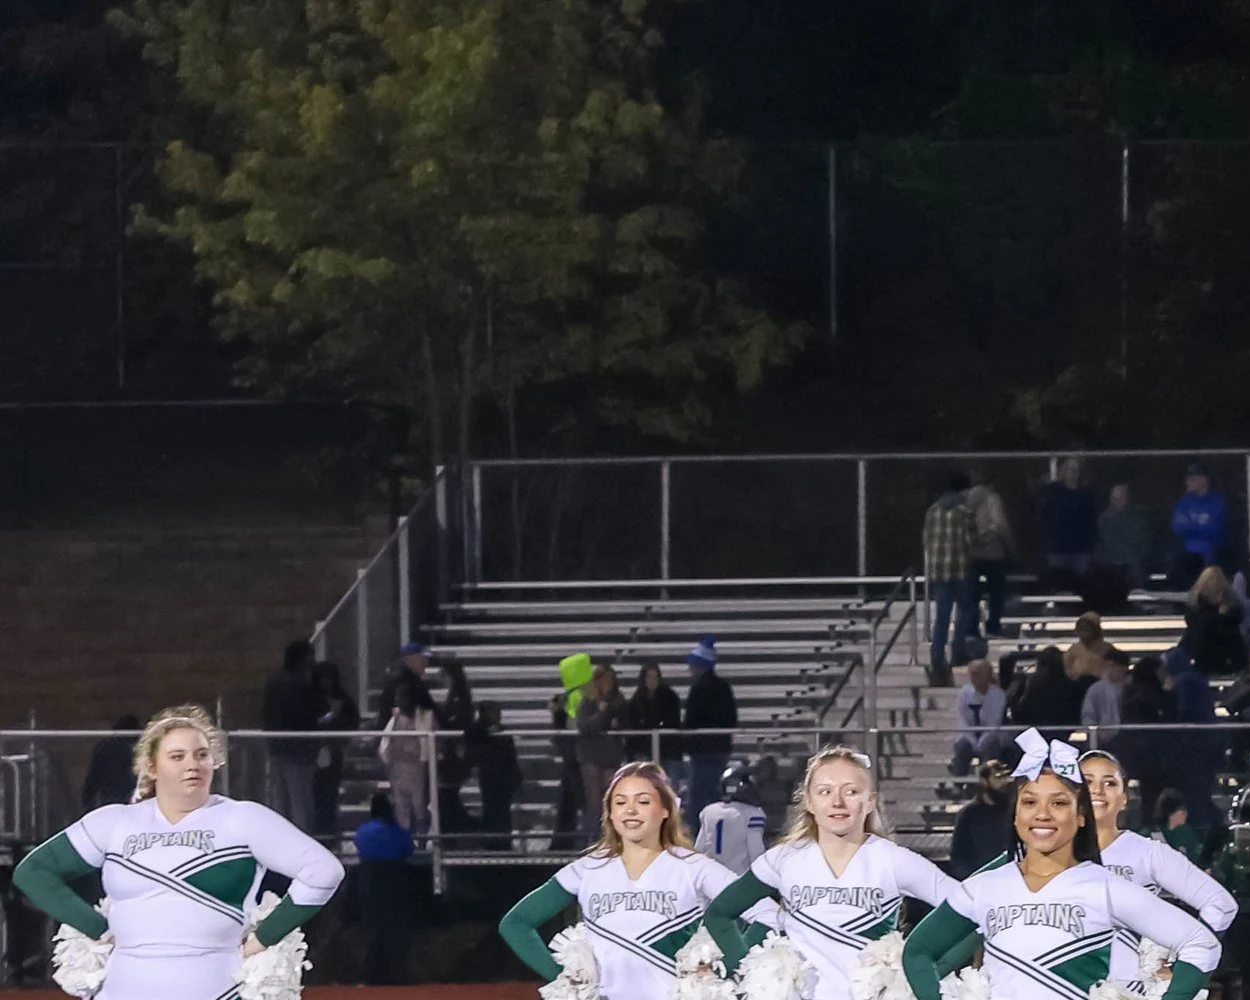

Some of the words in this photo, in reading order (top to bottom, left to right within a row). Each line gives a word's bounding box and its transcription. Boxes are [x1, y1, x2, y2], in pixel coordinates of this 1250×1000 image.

[122, 829, 215, 860] CAPTAINS
[588, 890, 678, 923] CAPTAINS
[790, 884, 884, 919] CAPTAINS
[986, 903, 1086, 941] CAPTAINS
